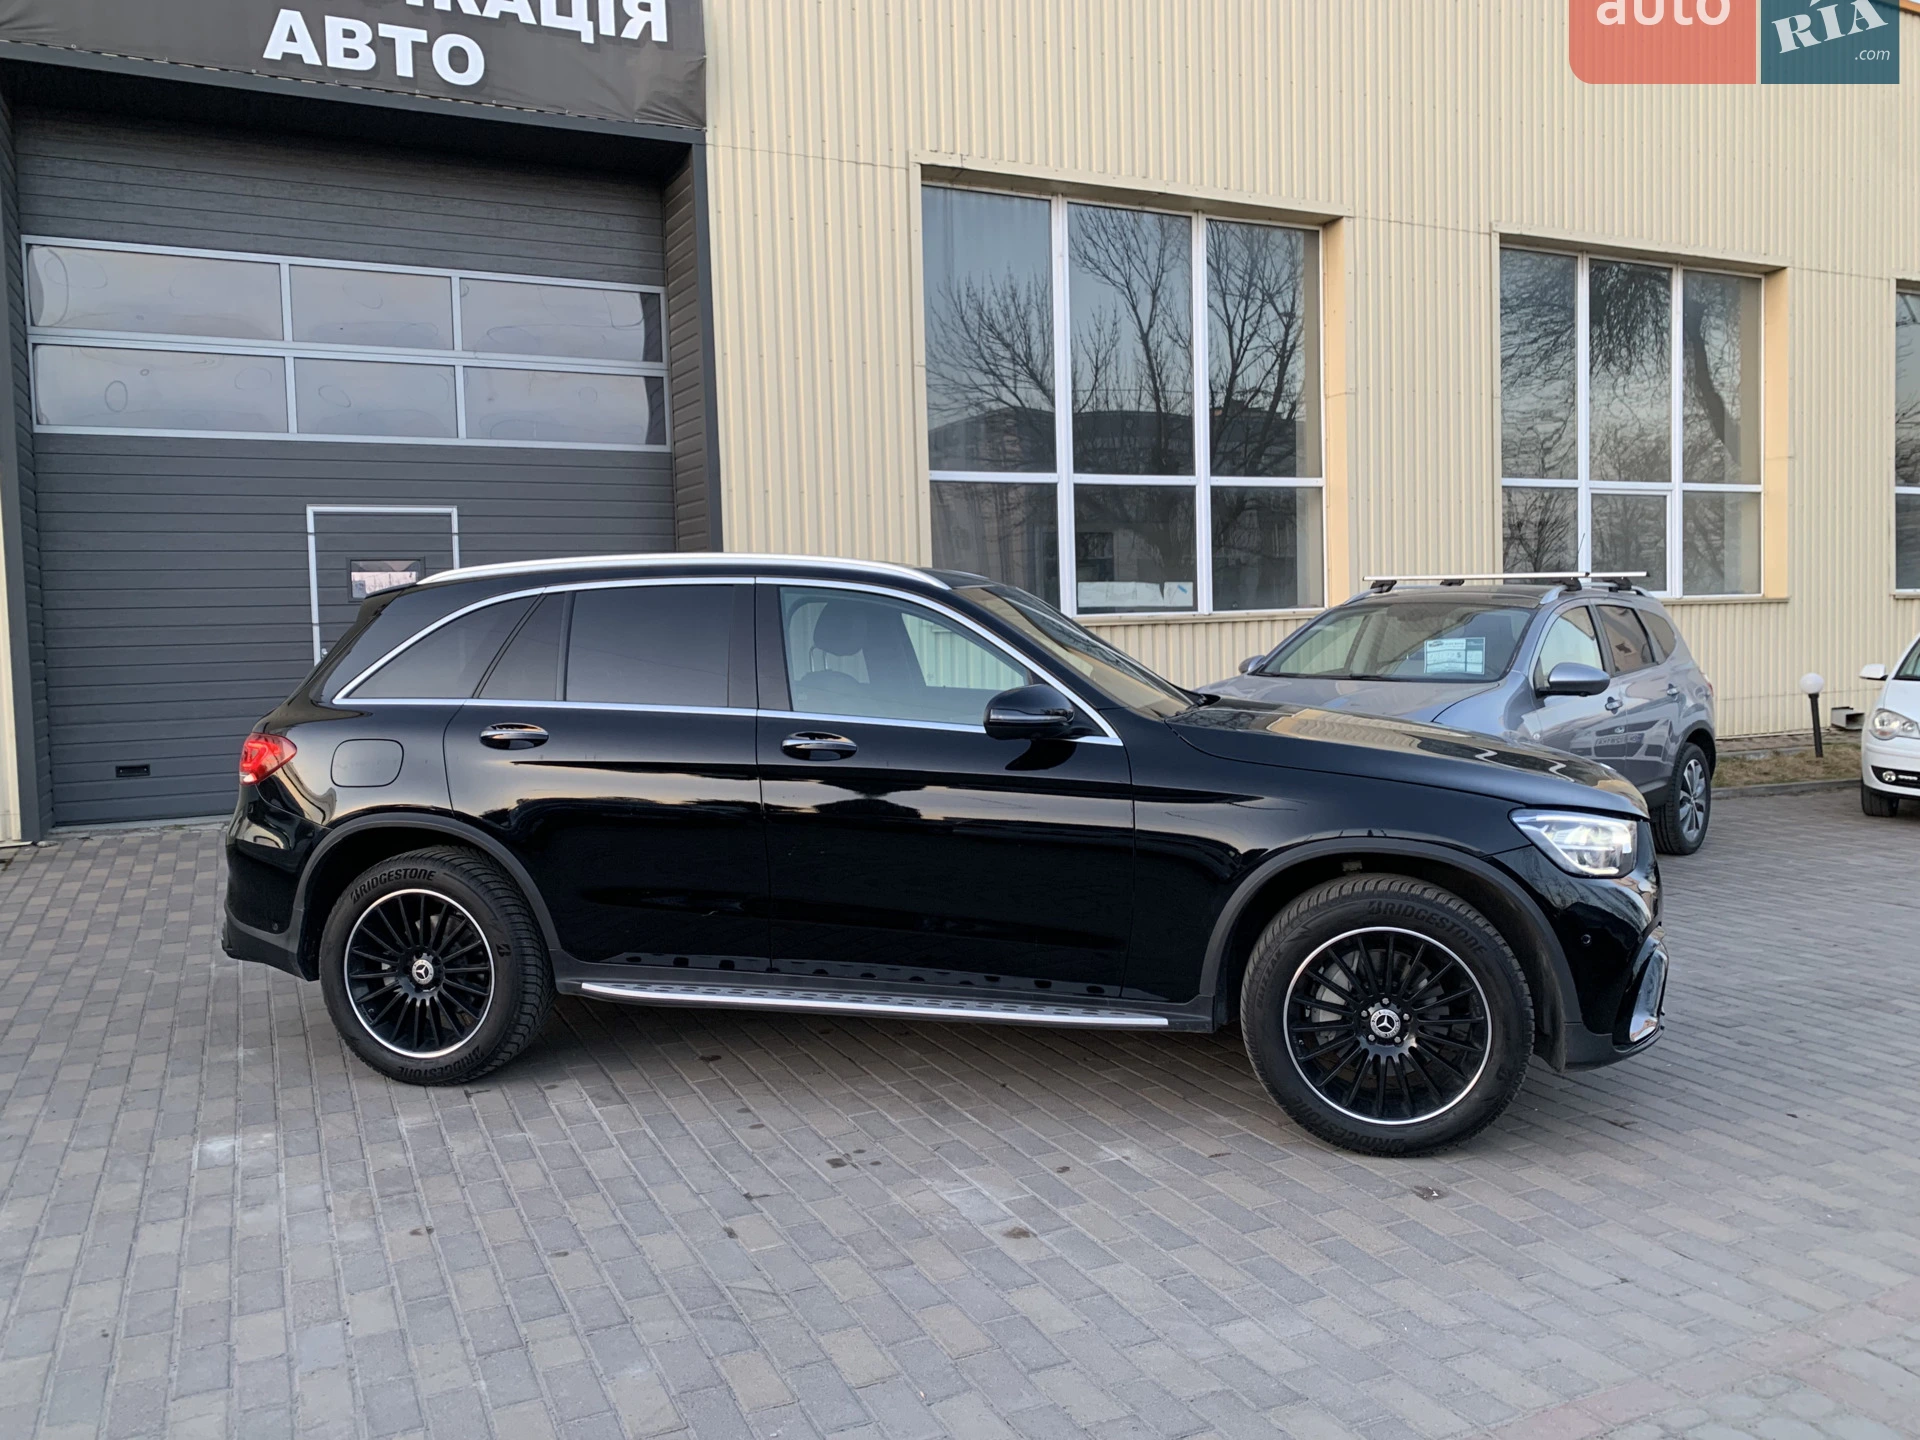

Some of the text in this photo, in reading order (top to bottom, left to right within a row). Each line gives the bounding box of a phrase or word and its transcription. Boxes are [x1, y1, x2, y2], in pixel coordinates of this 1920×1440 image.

[406, 0, 668, 44] ЦІЯ
[262, 8, 485, 86] АВТО
[350, 867, 436, 905] BRIDGESTONE
[1367, 899, 1487, 954] BRIDGESTONE
